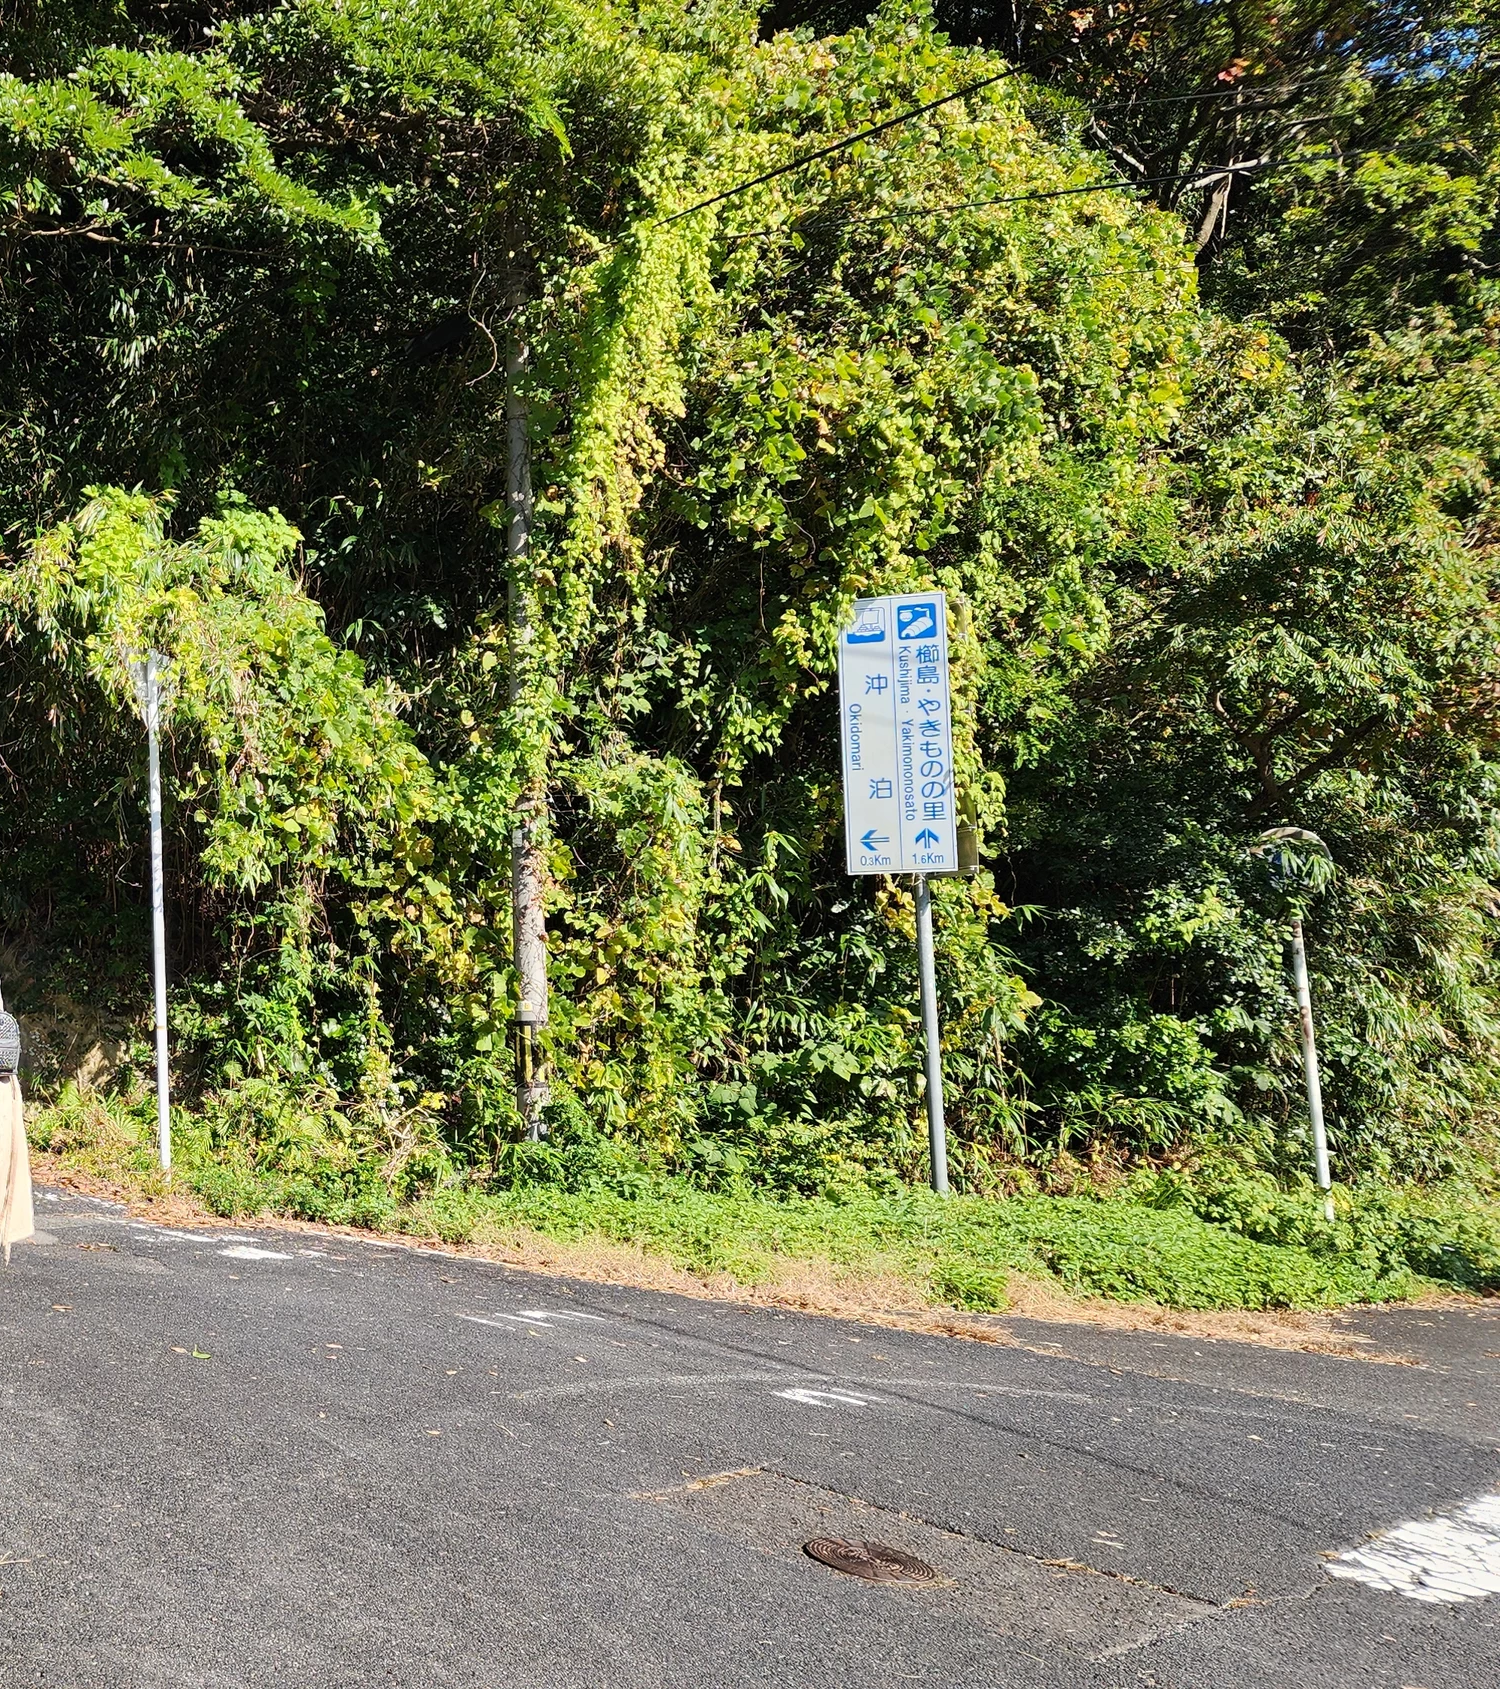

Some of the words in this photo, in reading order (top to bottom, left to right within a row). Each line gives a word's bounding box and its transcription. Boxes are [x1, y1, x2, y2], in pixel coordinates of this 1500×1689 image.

[898, 645, 913, 704] Kushijima
[849, 703, 865, 771] Okidomari
[901, 718, 918, 821] Yakimononosato
[860, 854, 892, 866] 0.3Km
[912, 852, 945, 865] 1.6Km
